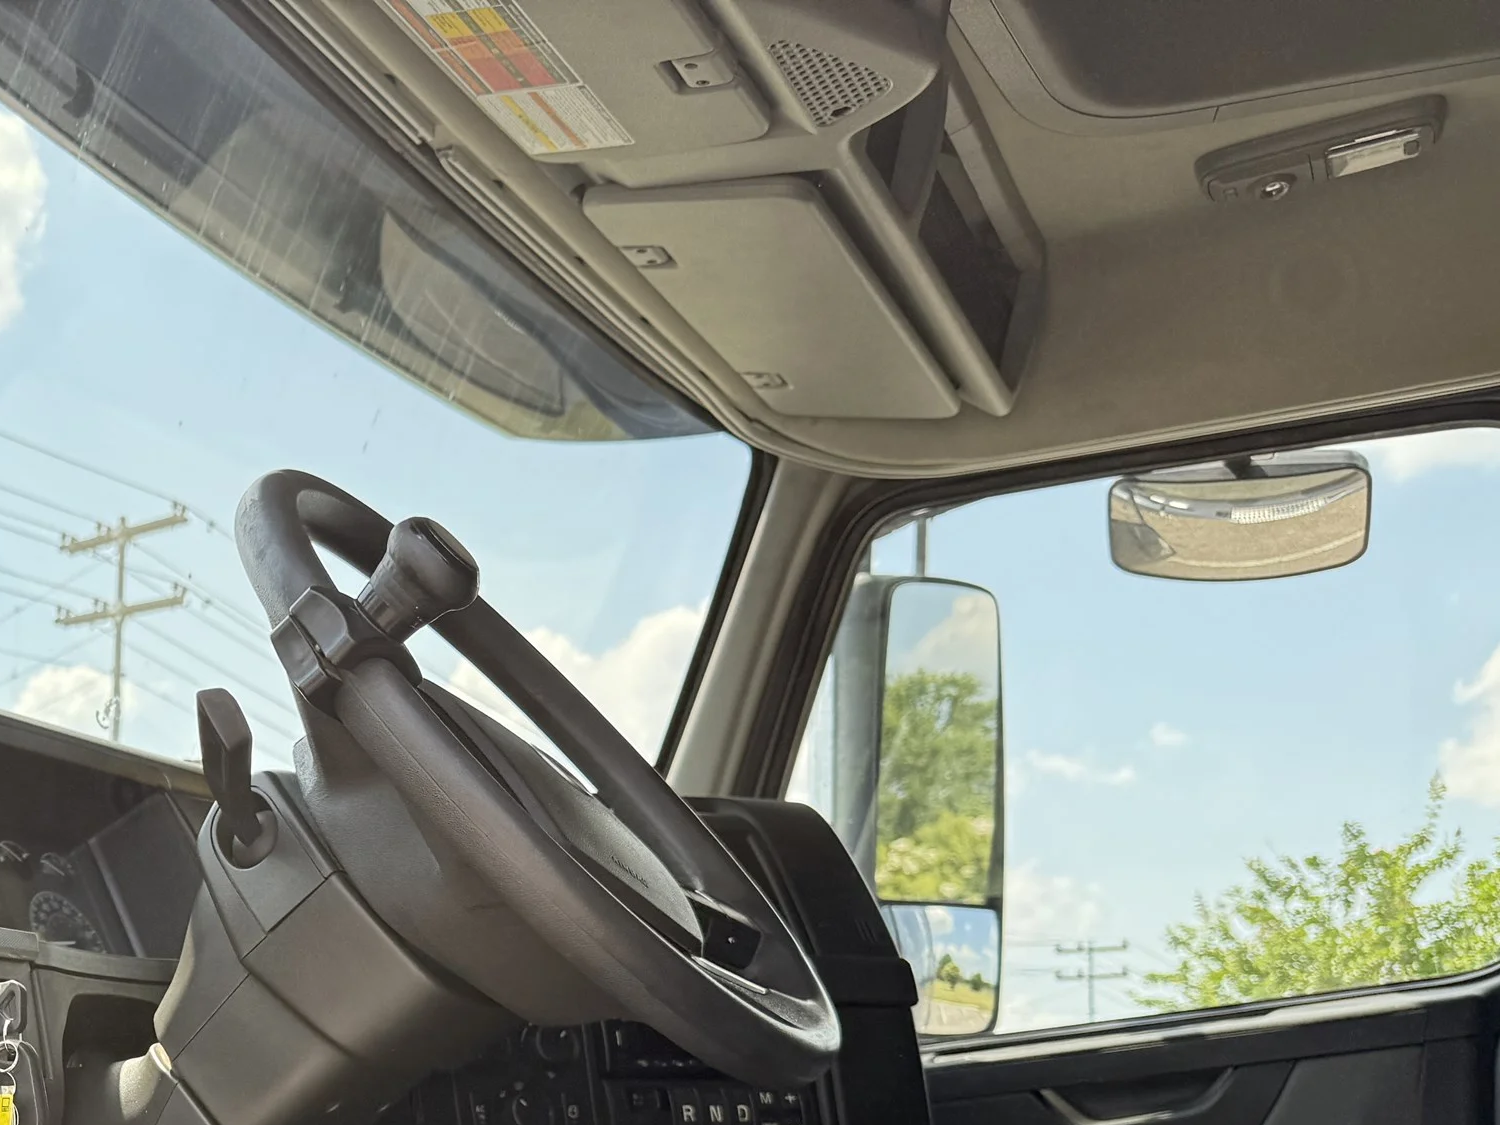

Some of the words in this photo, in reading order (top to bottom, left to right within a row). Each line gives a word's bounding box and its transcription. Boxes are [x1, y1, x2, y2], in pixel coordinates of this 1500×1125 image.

[760, 1092, 772, 1104] M
[682, 1104, 695, 1122] R
[709, 1105, 723, 1122] N
[737, 1104, 749, 1122] D
